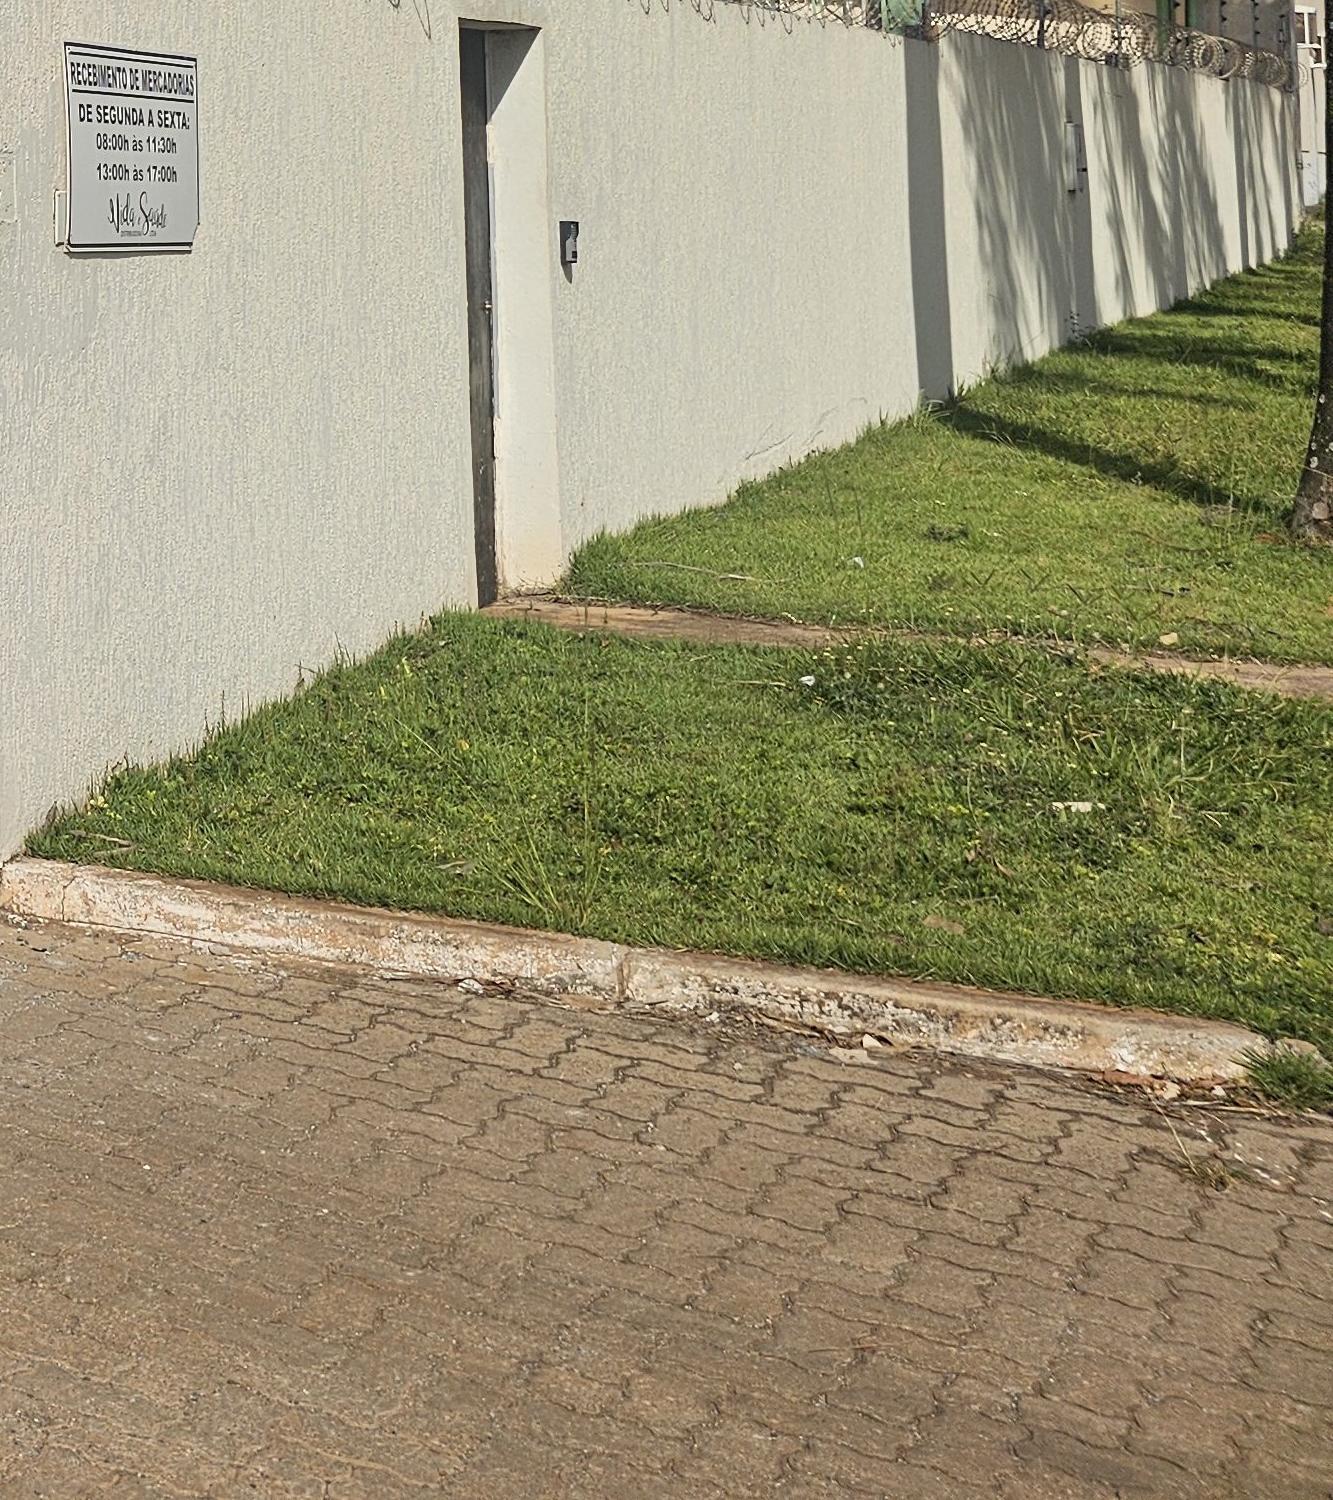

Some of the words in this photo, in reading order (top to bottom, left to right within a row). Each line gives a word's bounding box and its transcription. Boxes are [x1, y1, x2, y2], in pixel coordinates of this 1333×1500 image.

[70, 62, 127, 89] RECEBIMENTO
[129, 68, 139, 91] DE
[141, 69, 194, 96] MERCADORIAS
[78, 104, 93, 122] DE
[96, 105, 145, 127] SEGUNDA
[148, 109, 154, 128] A
[157, 110, 190, 130] SEXTA:
[96, 133, 130, 151] 08:00h
[132, 134, 143, 153] às
[146, 135, 177, 154] 11:30h
[97, 162, 130, 181] 13:00h
[133, 164, 144, 181] às
[147, 165, 177, 182] 17:00h
